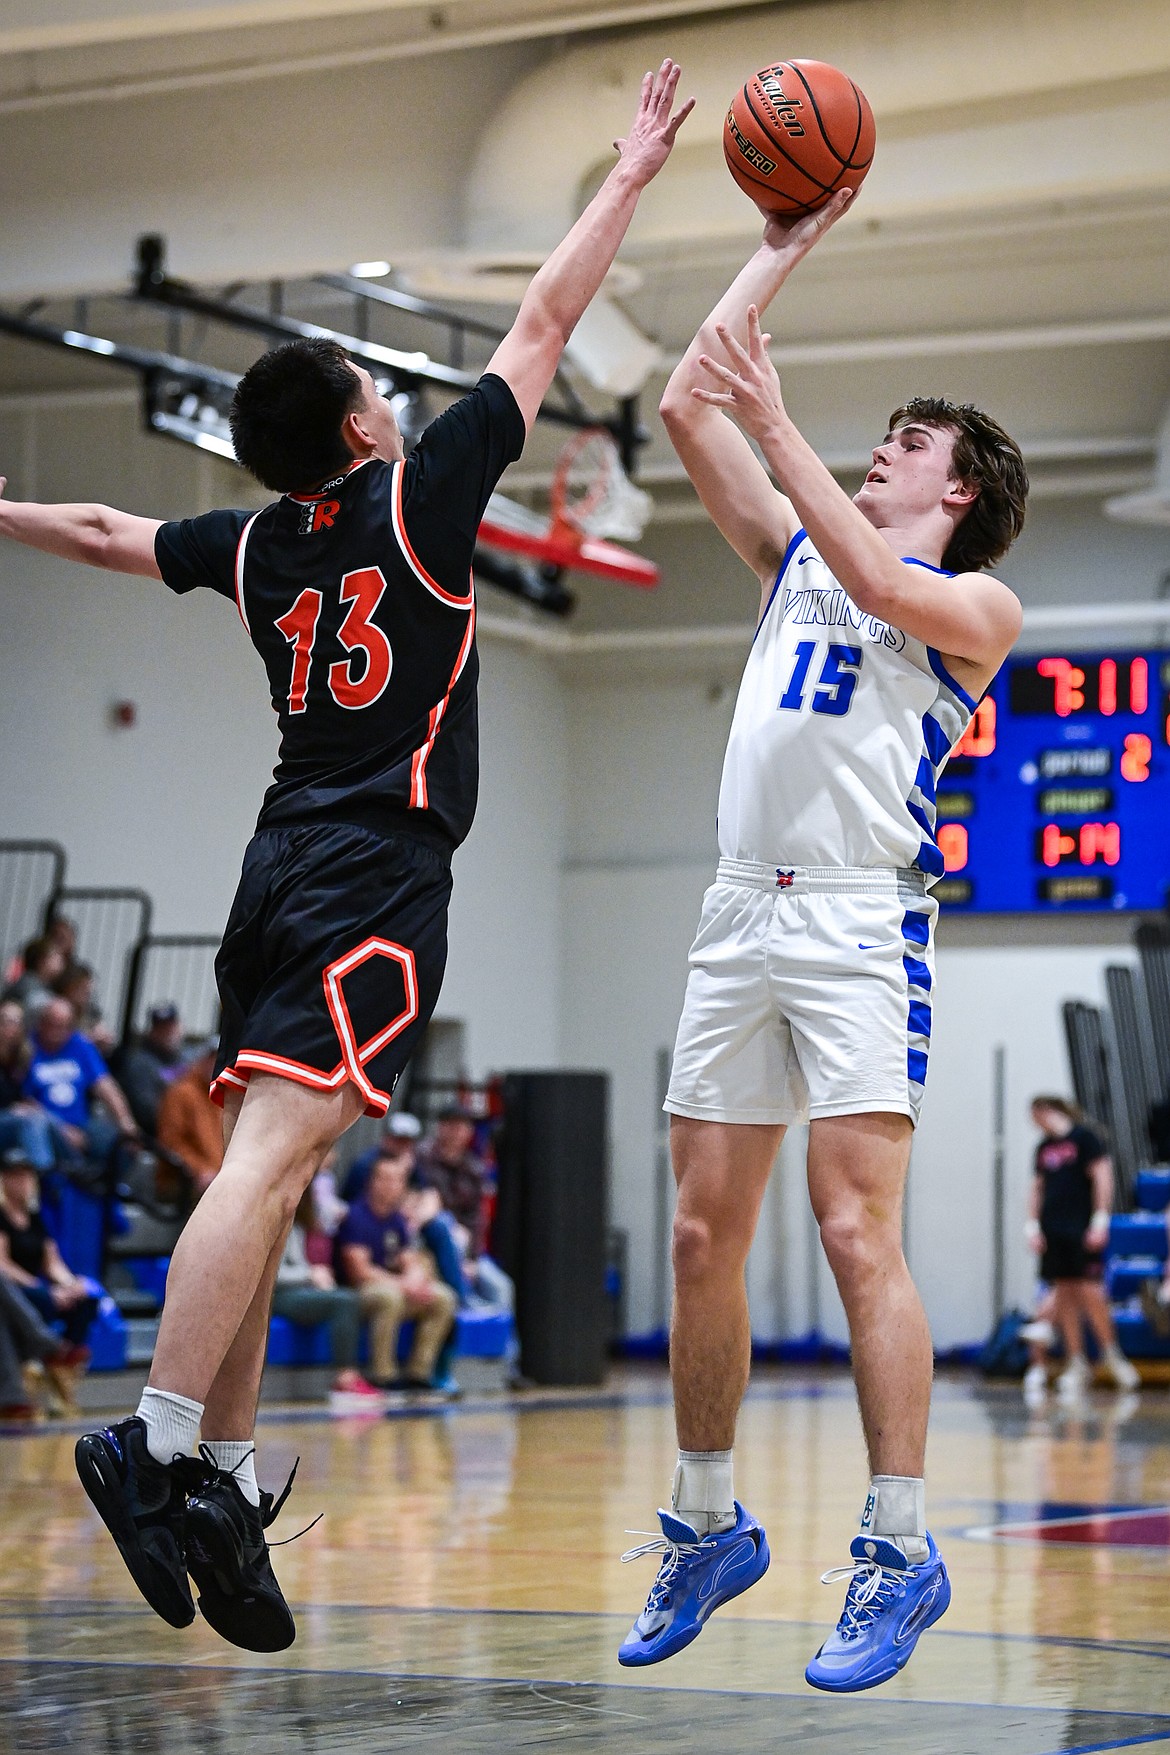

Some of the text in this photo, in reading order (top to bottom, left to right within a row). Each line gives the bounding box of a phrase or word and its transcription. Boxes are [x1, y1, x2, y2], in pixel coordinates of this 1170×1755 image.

[756, 66, 806, 137] Baden
[744, 145, 775, 174] PRO
[273, 565, 393, 715] 13
[781, 588, 906, 653] VIKINGS
[776, 638, 864, 719] 15
[1037, 657, 1149, 717] 7:11
[1120, 733, 1152, 783] 2
